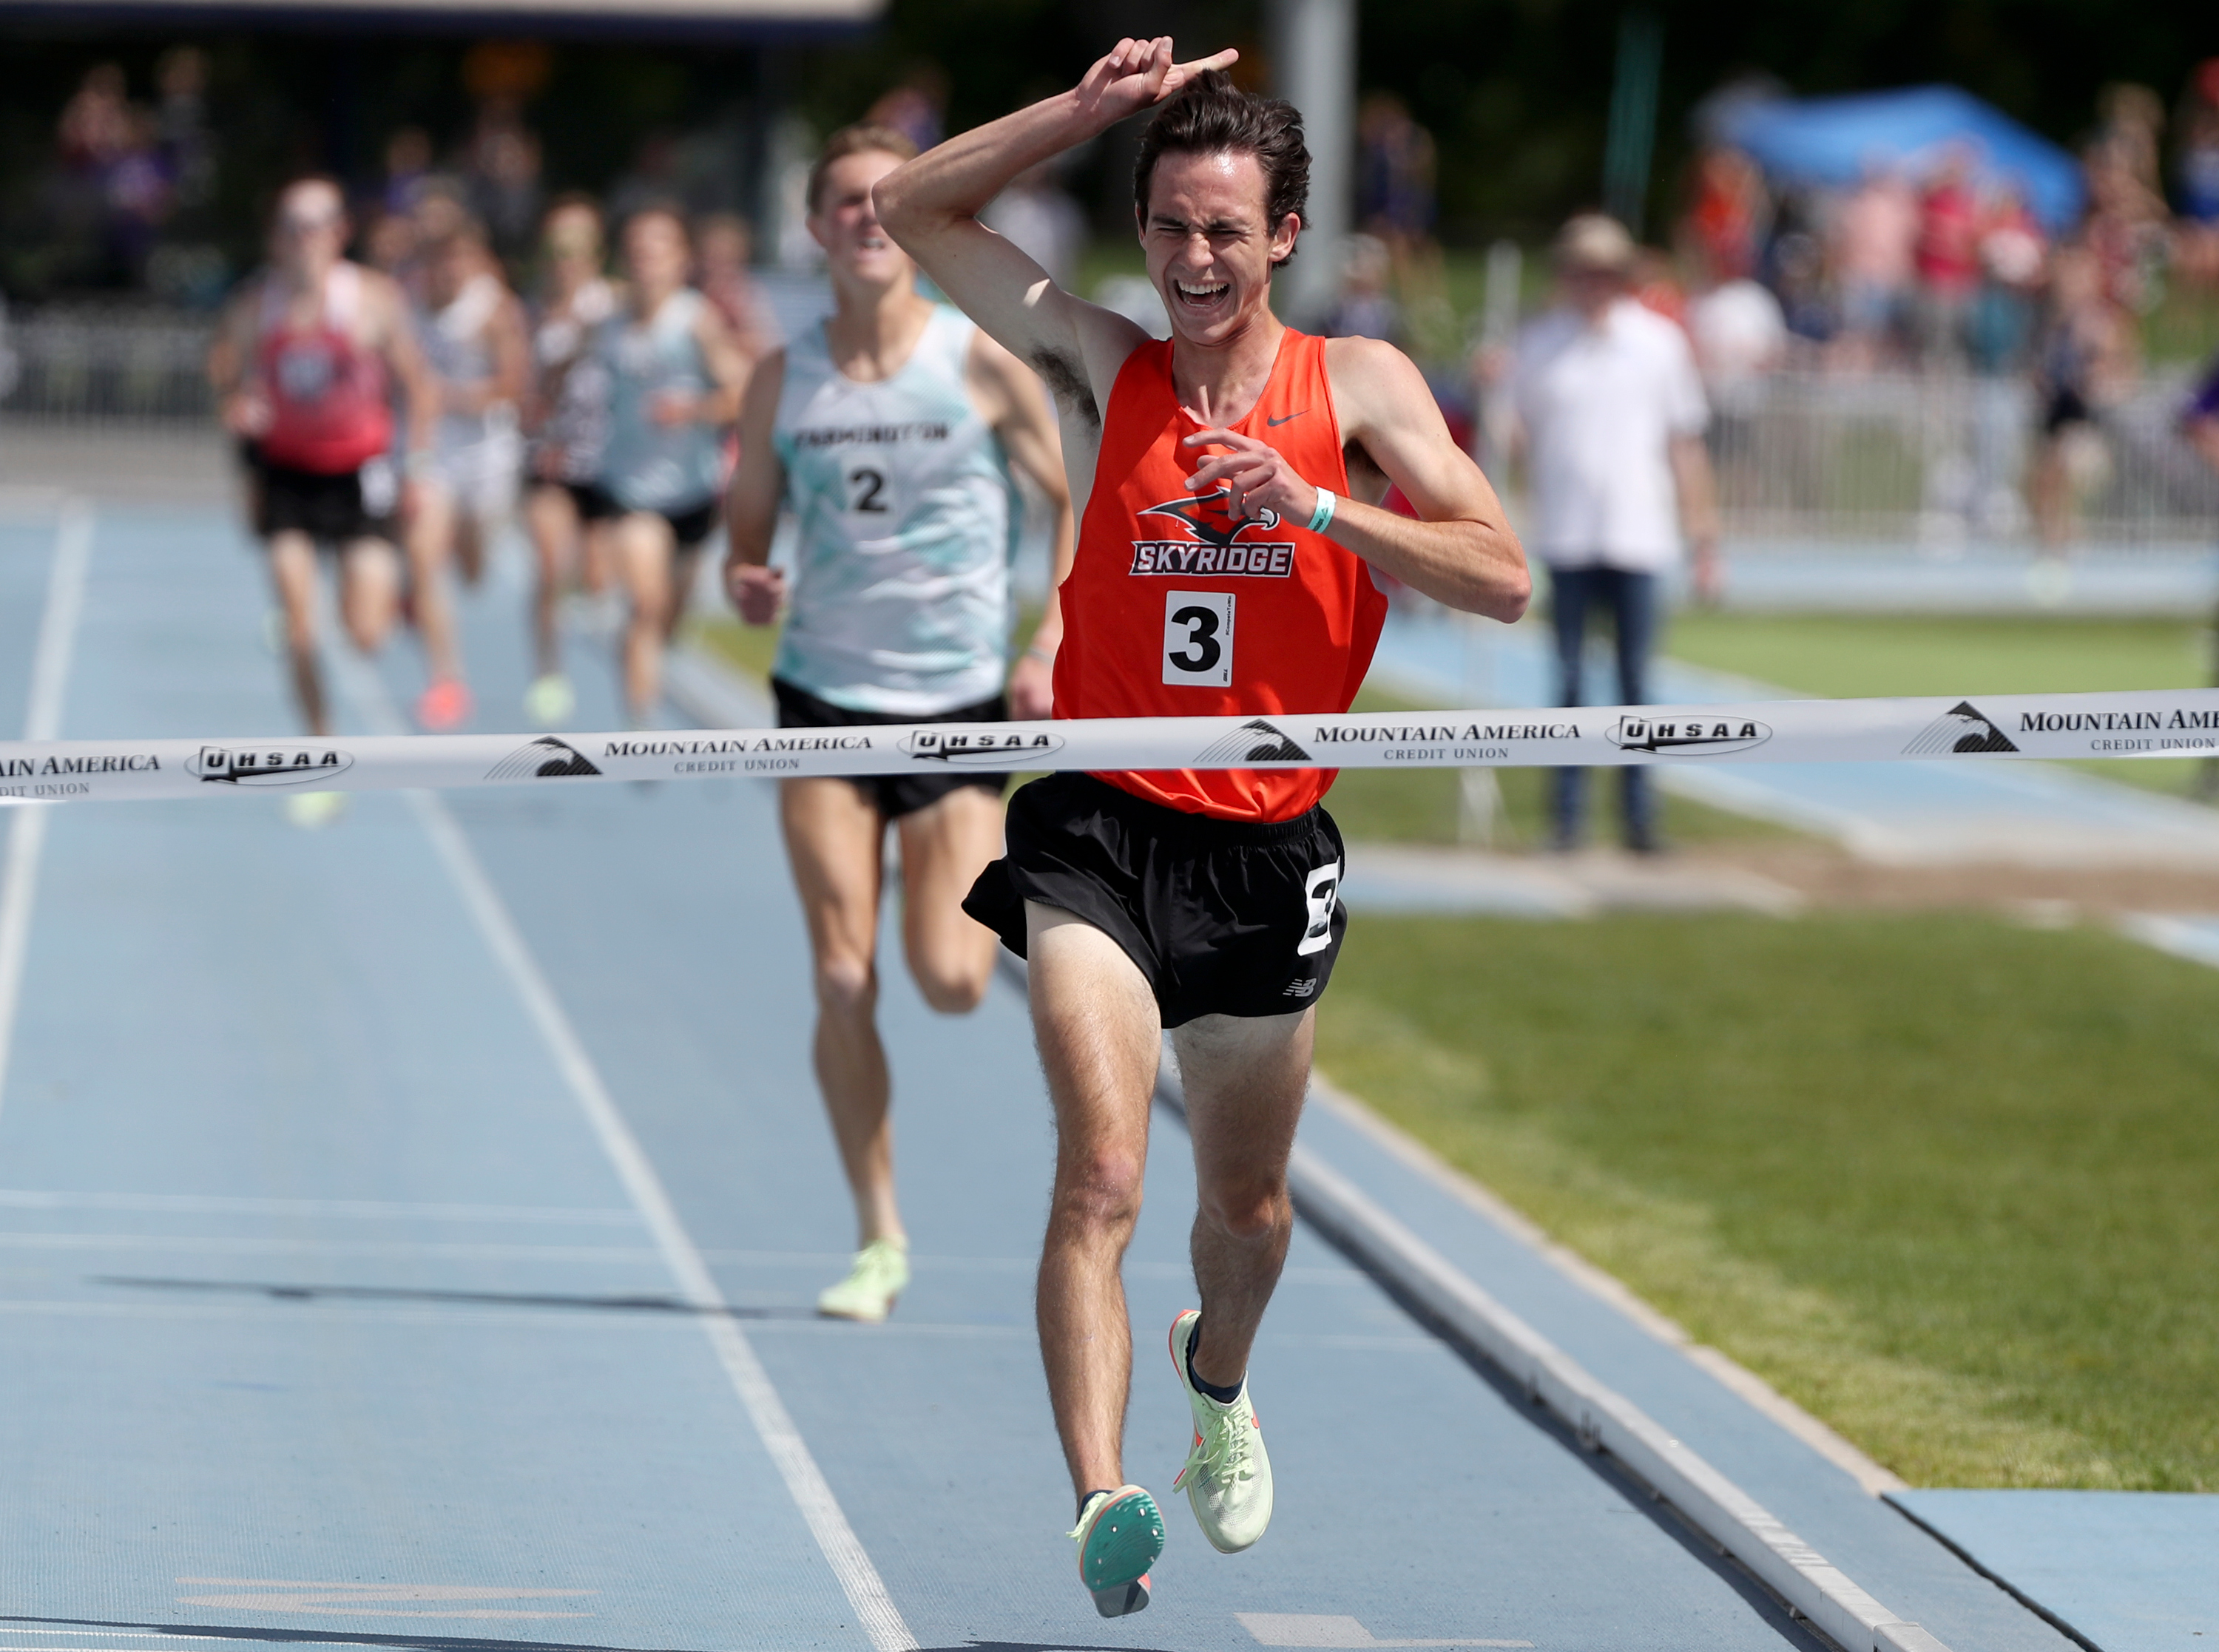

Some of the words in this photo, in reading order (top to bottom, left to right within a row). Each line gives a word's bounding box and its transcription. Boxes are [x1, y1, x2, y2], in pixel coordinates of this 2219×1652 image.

[851, 469, 888, 512] 2
[1137, 546, 1290, 573] SKYRIDGE
[1168, 606, 1221, 672] 3
[1627, 722, 1757, 738] UHSAA
[918, 734, 1050, 748] UHSAA
[2091, 739, 2152, 750] CREDIT
[2161, 738, 2216, 749] UNION
[206, 751, 339, 768] UHSAA
[1384, 748, 1445, 759] CREDIT
[1453, 748, 1510, 759] UNION
[674, 760, 737, 773] CREDIT
[744, 758, 800, 771] UNION
[35, 782, 89, 796] UNION
